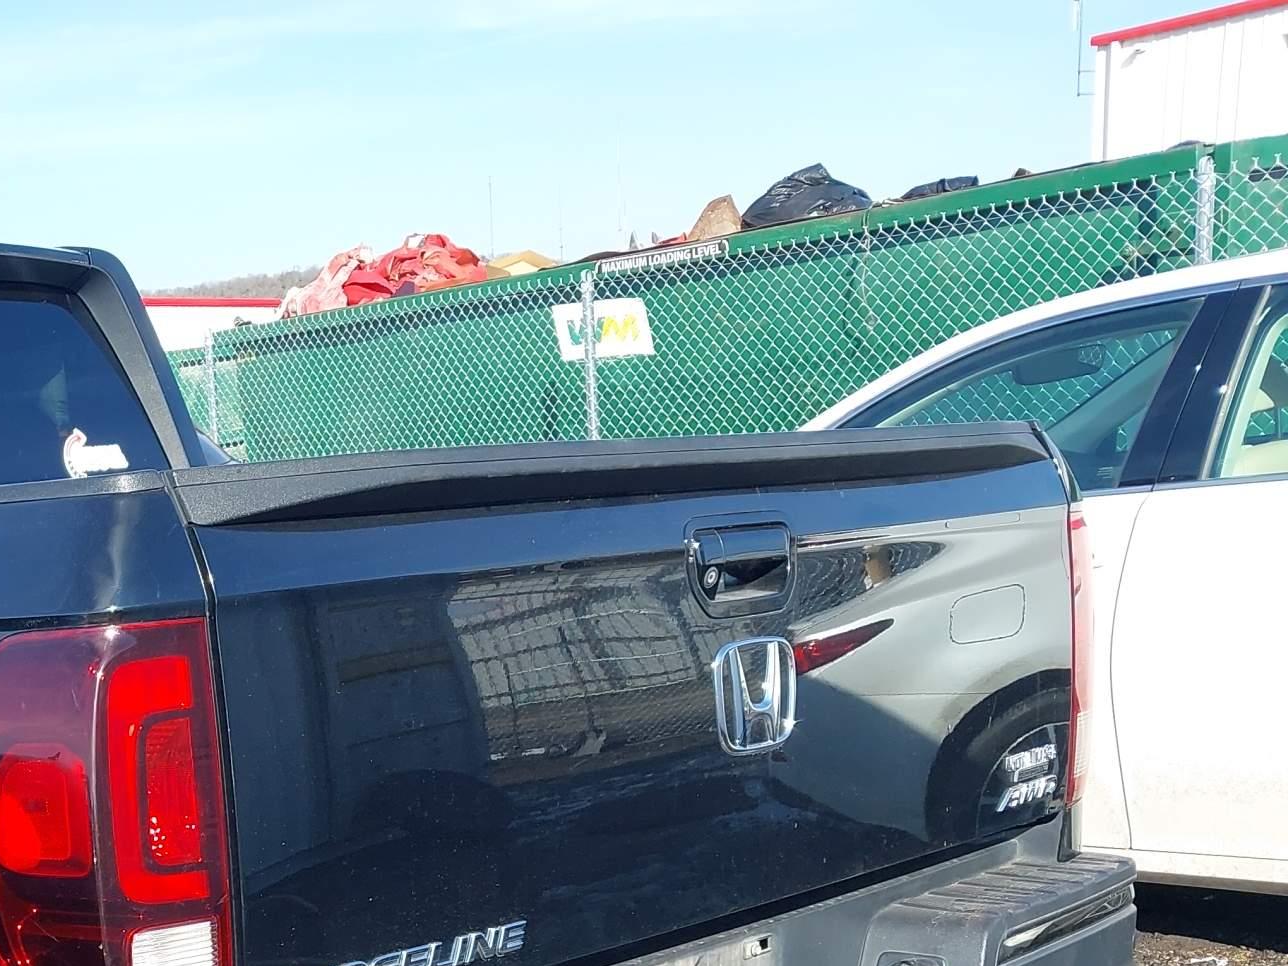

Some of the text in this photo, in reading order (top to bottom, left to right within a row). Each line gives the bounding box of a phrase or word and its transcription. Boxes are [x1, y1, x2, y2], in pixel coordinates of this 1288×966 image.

[601, 243, 722, 273] MAXIMUM LOADING LEVEL
